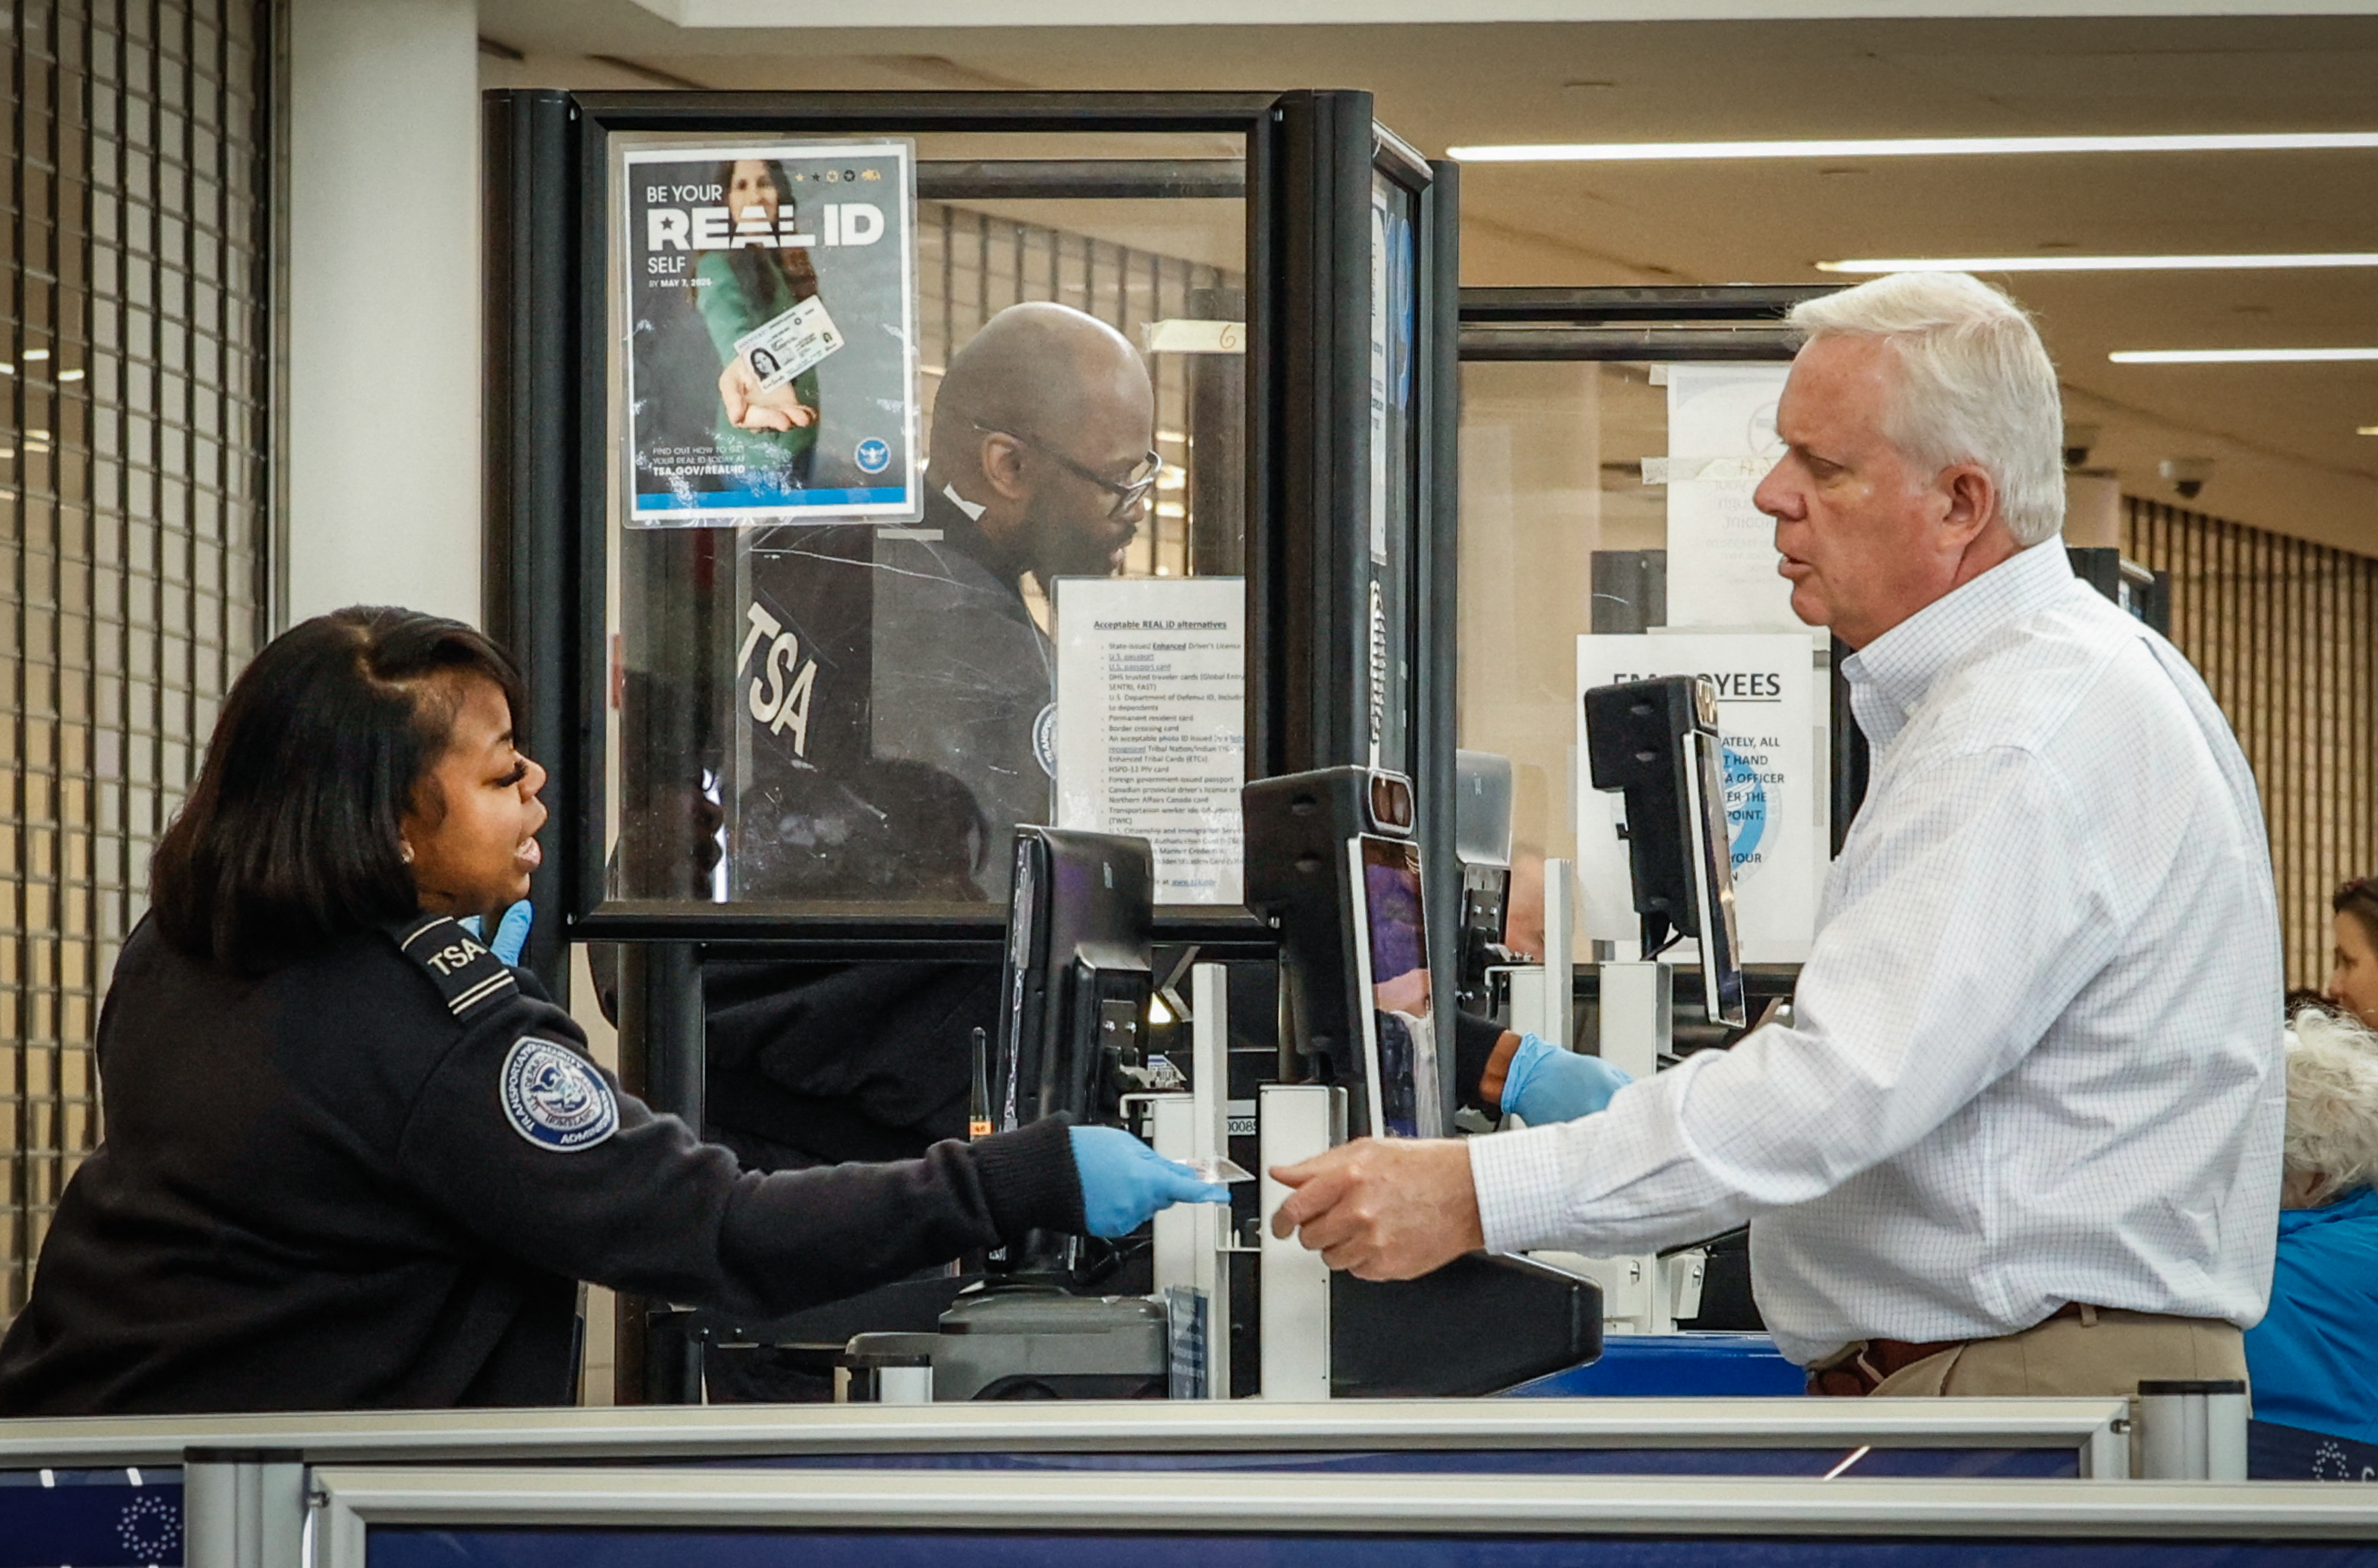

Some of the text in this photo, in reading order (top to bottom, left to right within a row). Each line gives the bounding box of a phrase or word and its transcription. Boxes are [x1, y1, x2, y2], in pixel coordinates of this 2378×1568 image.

[647, 185, 722, 203] BE YOUR
[648, 204, 884, 251] REAL ID
[648, 256, 686, 274] SELF
[1094, 620, 1140, 630] Acceptable
[1177, 620, 1227, 629] alternatives
[737, 601, 818, 757] TSA
[1760, 737, 1780, 747] ALL
[1734, 756, 1768, 765] HAND
[1737, 774, 1784, 784] OFFICER
[1746, 792, 1767, 802] THE
[427, 937, 488, 976] TSA
